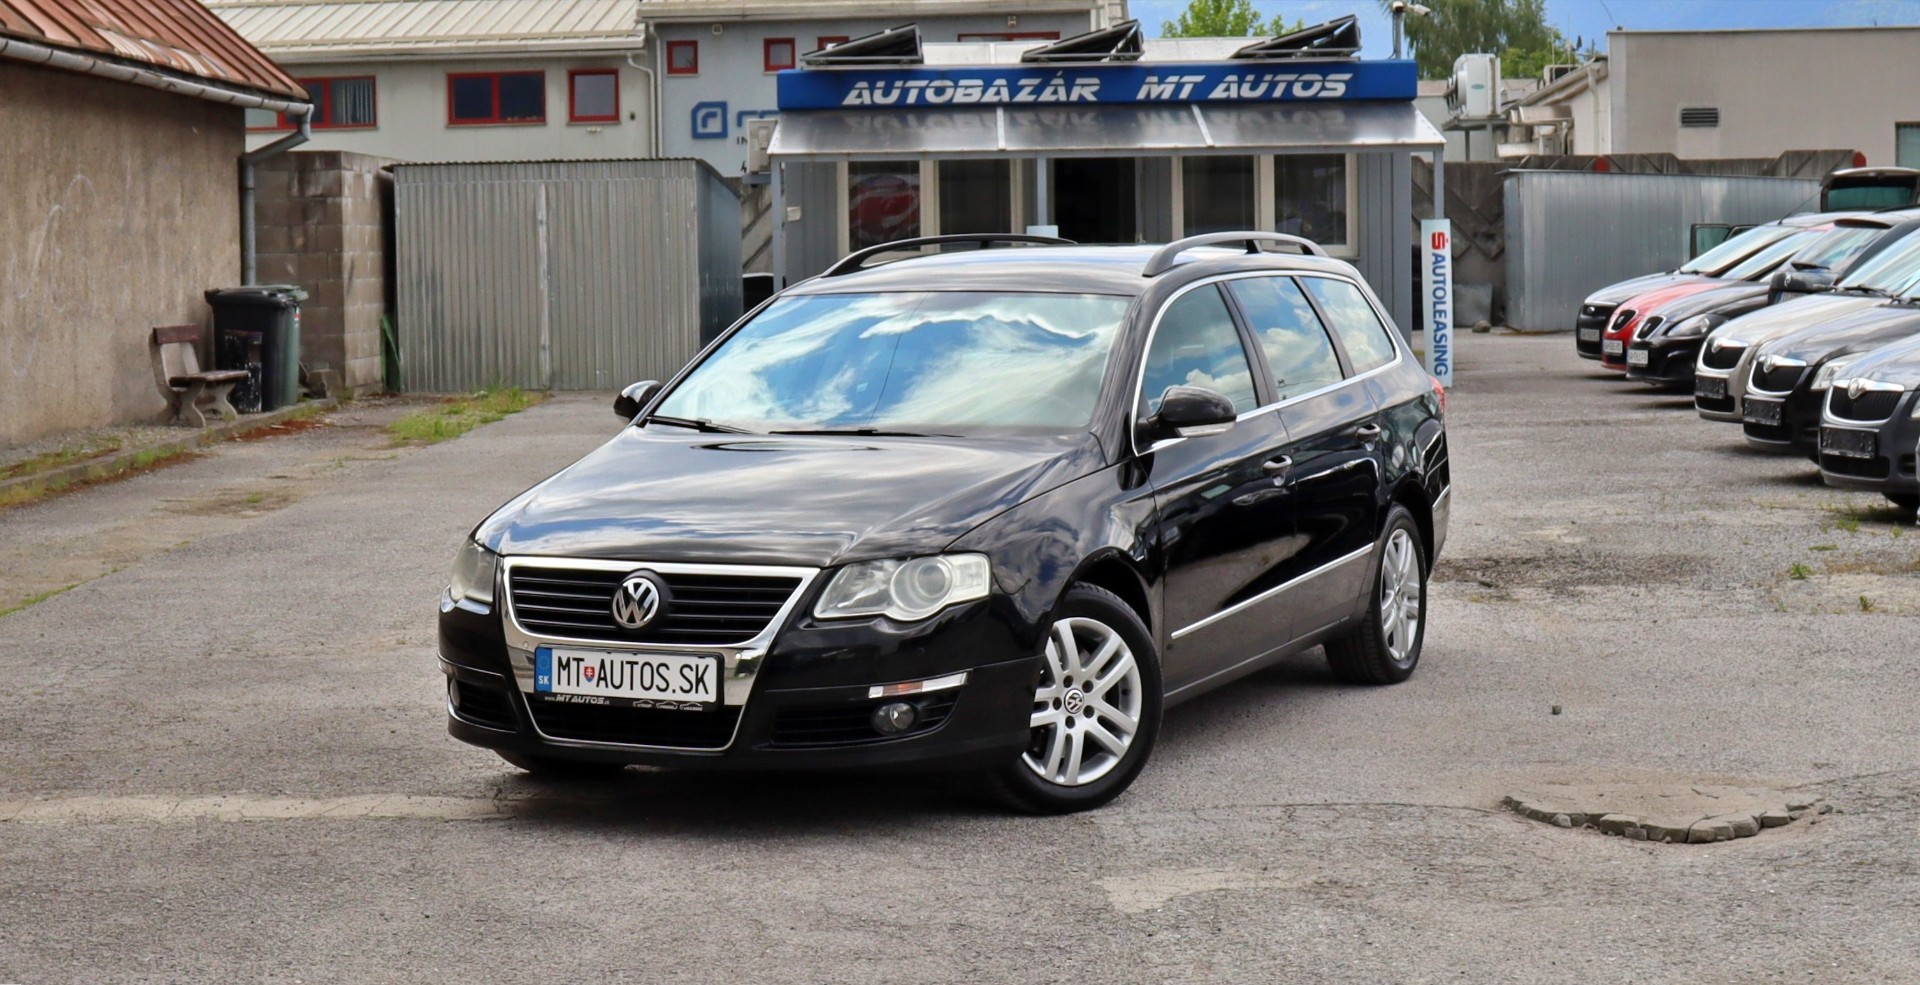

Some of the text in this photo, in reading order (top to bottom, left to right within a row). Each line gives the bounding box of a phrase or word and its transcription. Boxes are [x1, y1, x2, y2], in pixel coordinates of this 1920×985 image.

[842, 70, 1354, 105] AUTOBAZÁR MT AUTOS
[1432, 253, 1449, 376] AUTOLEASING
[538, 675, 549, 685] SK
